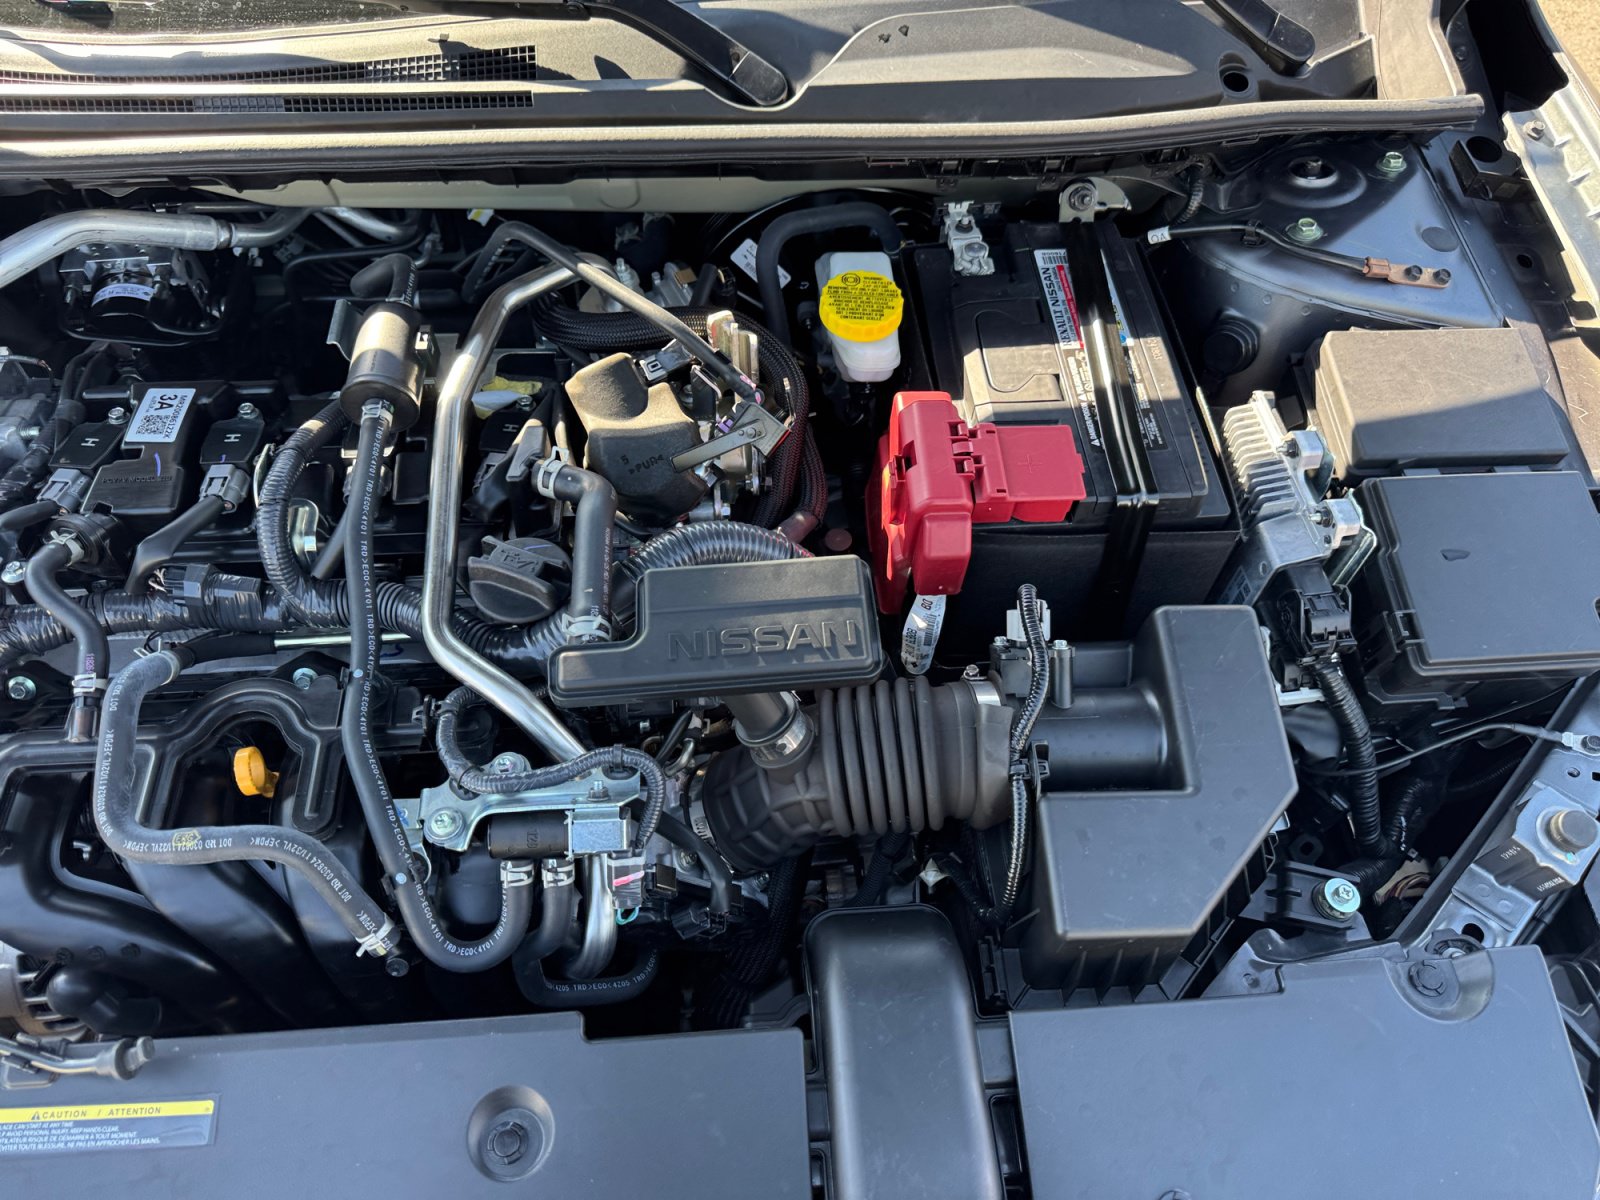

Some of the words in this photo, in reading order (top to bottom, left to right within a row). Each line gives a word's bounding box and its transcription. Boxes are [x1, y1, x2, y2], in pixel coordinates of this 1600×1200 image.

[1041, 267, 1061, 307] NISSAN
[1054, 310, 1072, 346] RENAULT
[154, 394, 178, 411] 3A
[666, 619, 857, 661] NISSAN
[42, 1110, 87, 1119] CAUTION
[108, 1106, 161, 1117] ATTENTION
